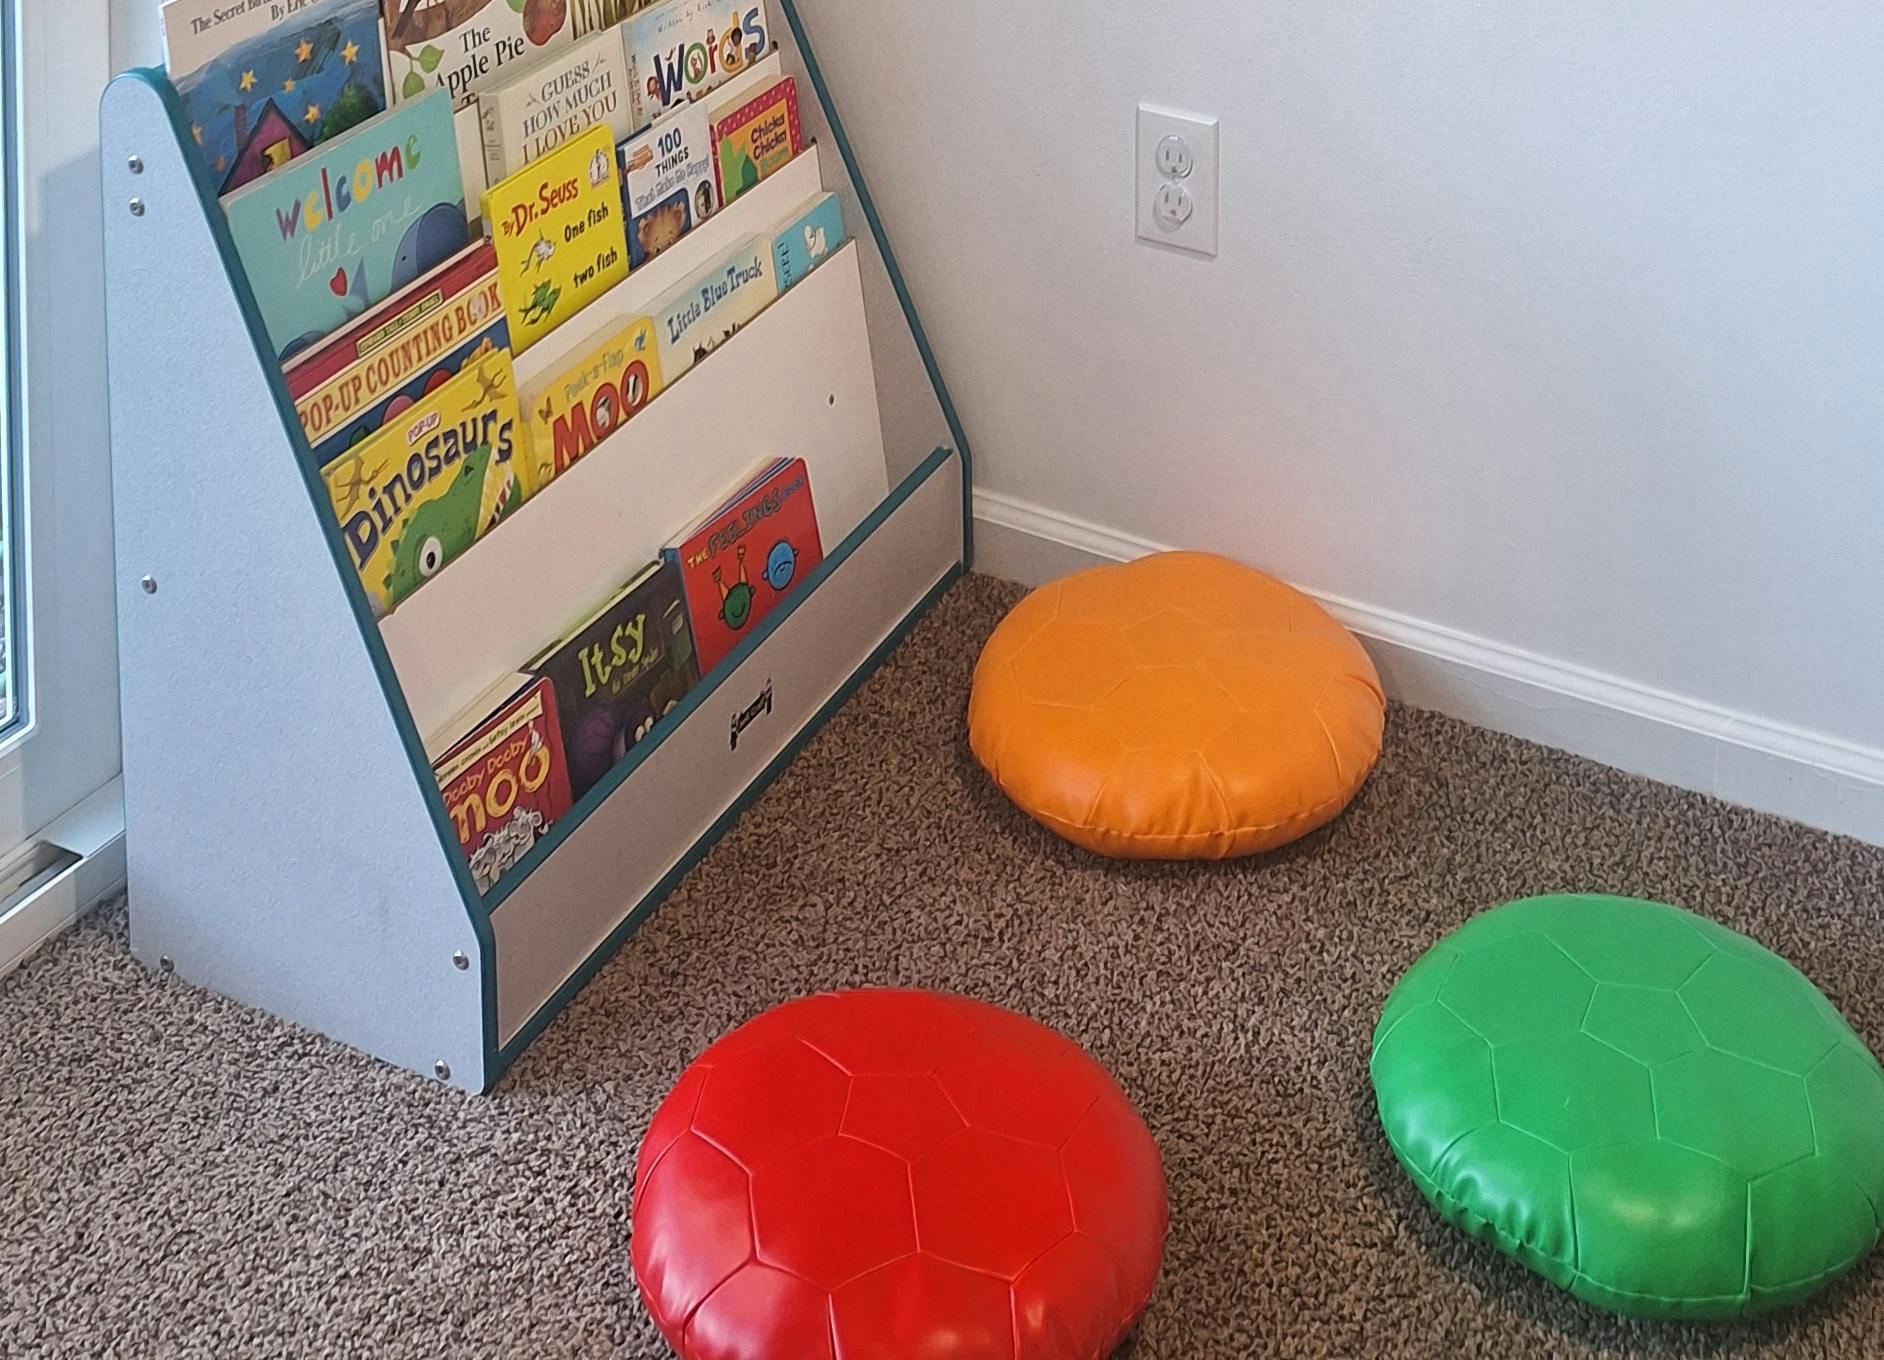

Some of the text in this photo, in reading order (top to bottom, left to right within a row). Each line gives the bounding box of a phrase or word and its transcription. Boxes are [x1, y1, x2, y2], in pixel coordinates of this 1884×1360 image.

[190, 15, 213, 35] The
[212, 0, 246, 27] Secret
[270, 3, 286, 22] By
[458, 25, 492, 55] The
[652, 6, 766, 108] Words
[434, 34, 526, 101] Apple Pie
[540, 59, 591, 103] GUESS
[520, 143, 530, 165] I
[535, 113, 581, 158] LOVE
[581, 89, 618, 128] YOU
[522, 100, 562, 139] HOW
[564, 69, 613, 114] MUCH
[750, 112, 786, 144] Chicka
[654, 145, 690, 178] THINGS
[657, 127, 682, 158] 100
[752, 129, 788, 161] Chicka
[275, 133, 422, 242] welcome
[511, 200, 539, 238] Dr.
[538, 177, 579, 216] Seuss
[371, 195, 423, 243] one
[563, 200, 610, 244] One fish
[572, 245, 618, 289] two fish
[666, 255, 764, 346] Little Blue Truck
[364, 309, 454, 396] COUNTING
[406, 411, 440, 441] POP-UP
[552, 359, 650, 477] MOO
[342, 407, 515, 571] Dinosaurs
[687, 546, 709, 570] THE
[707, 486, 782, 559] FEELINGS
[577, 613, 647, 698] Itsy
